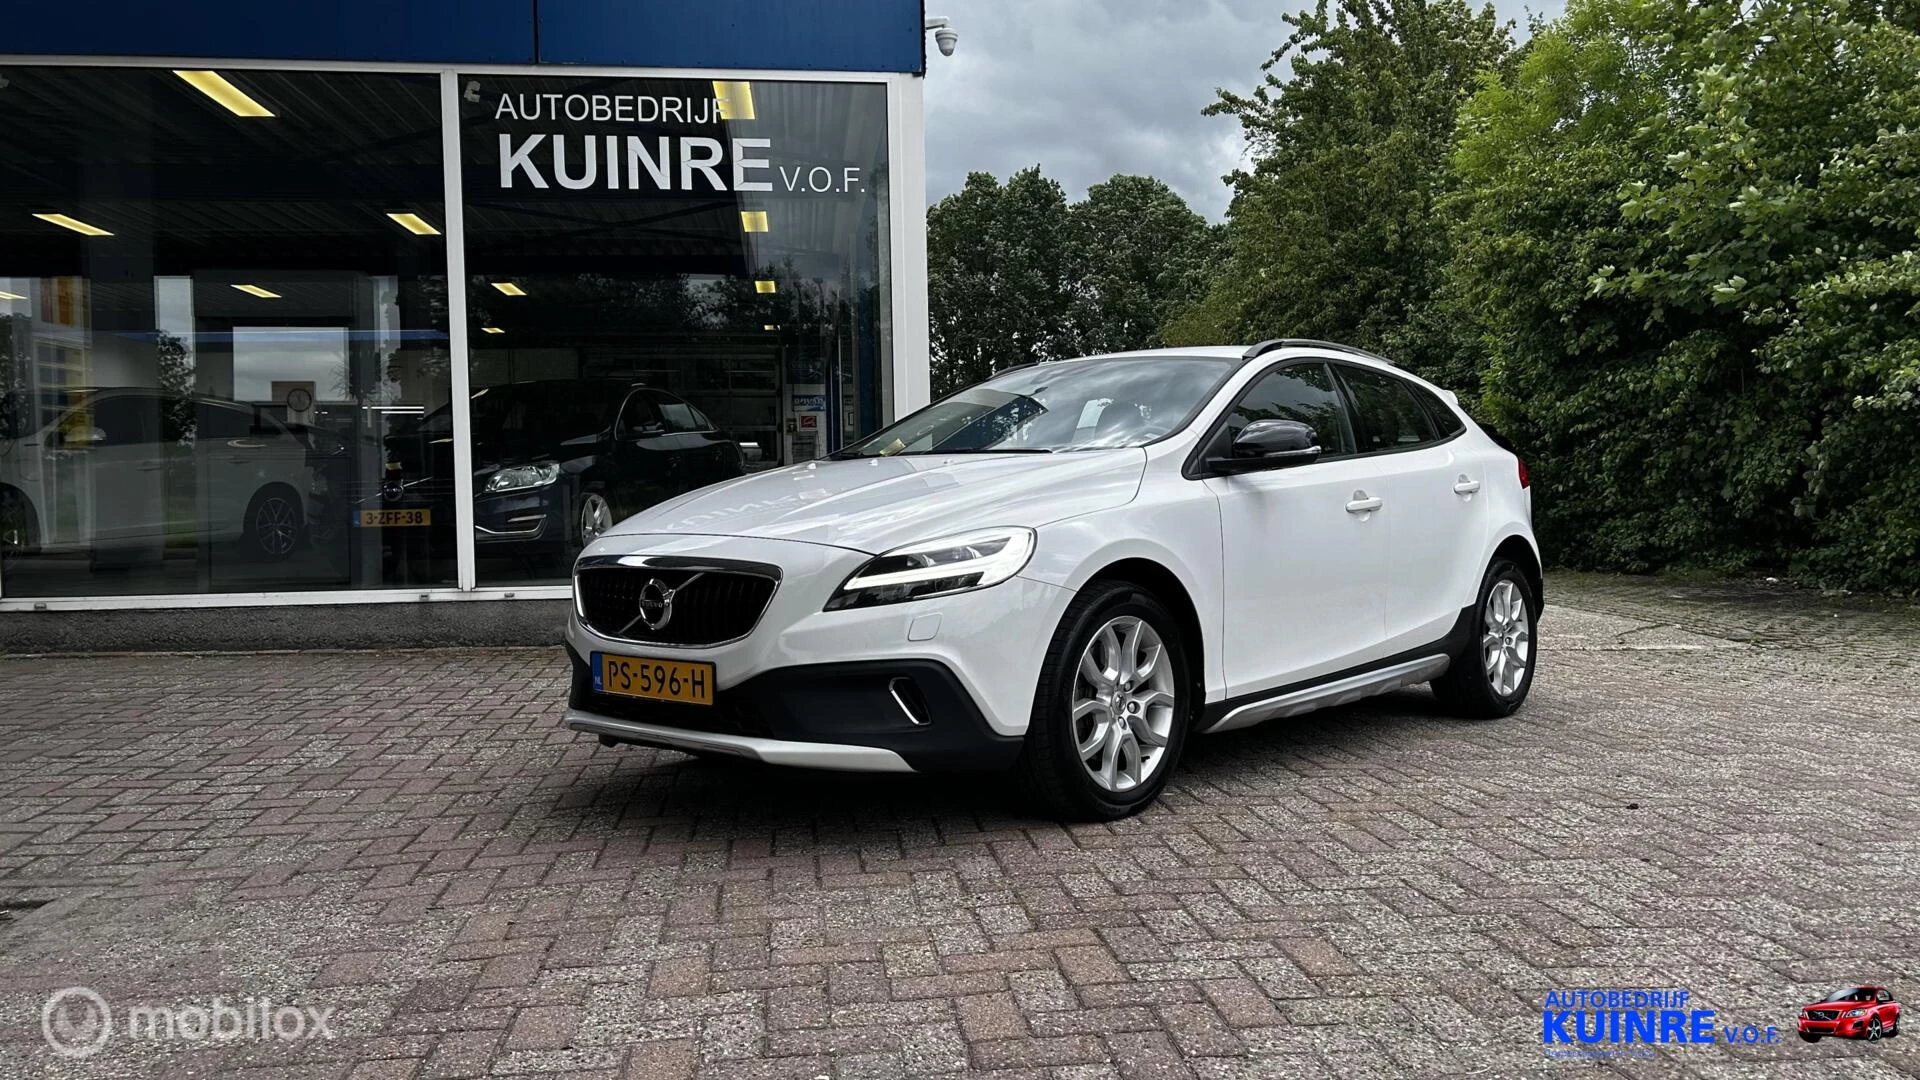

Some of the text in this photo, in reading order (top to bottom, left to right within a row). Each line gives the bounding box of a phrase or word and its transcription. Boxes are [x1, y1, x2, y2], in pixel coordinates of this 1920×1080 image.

[495, 93, 731, 123] AUTOBEDRIJF
[500, 133, 866, 192] KUINRE V.O.F.
[366, 511, 423, 525] 3-ZFF-38
[608, 660, 705, 698] PS-596-H
